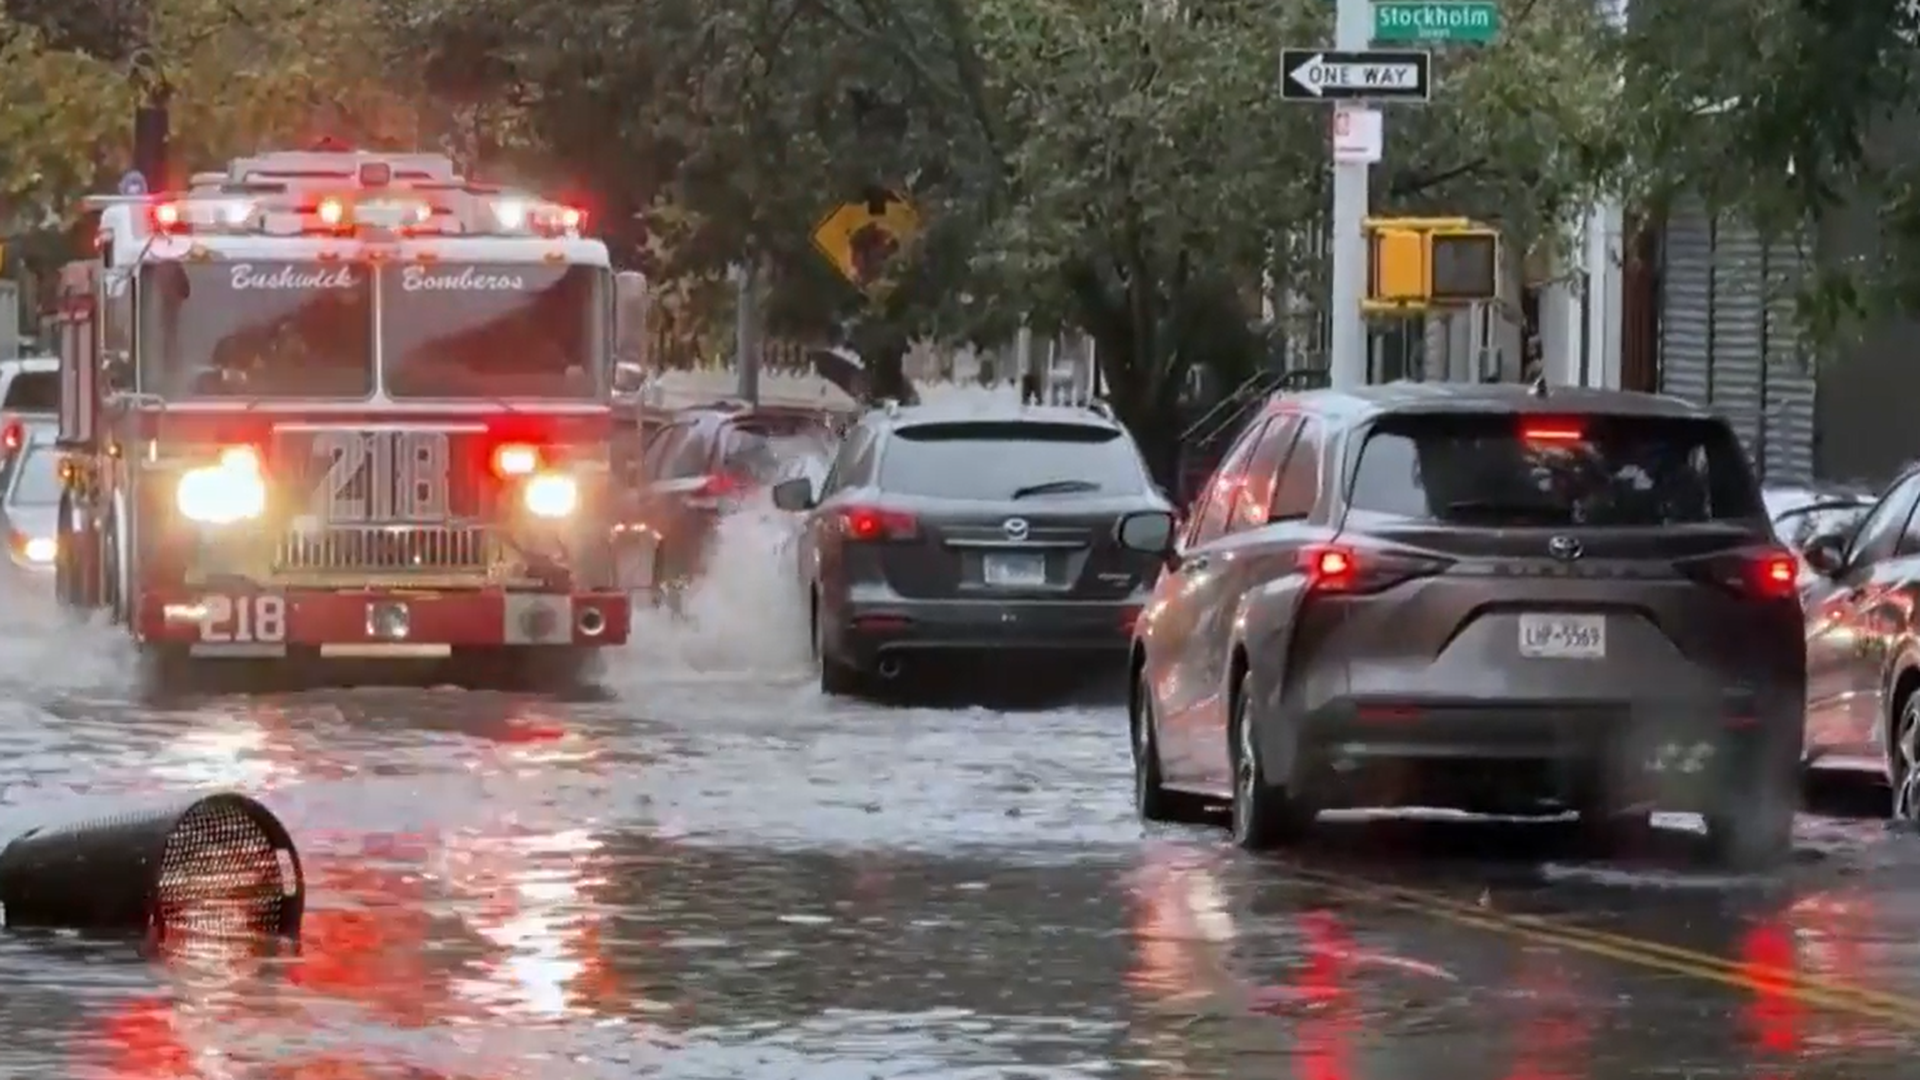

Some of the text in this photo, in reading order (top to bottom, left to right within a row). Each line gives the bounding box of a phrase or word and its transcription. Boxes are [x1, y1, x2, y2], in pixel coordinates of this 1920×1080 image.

[1379, 6, 1488, 26] Stockholm
[1308, 65, 1407, 84] ONE WAY
[231, 264, 524, 291] Bushwick Bomberos
[311, 430, 450, 524] 218
[200, 595, 285, 640] 218
